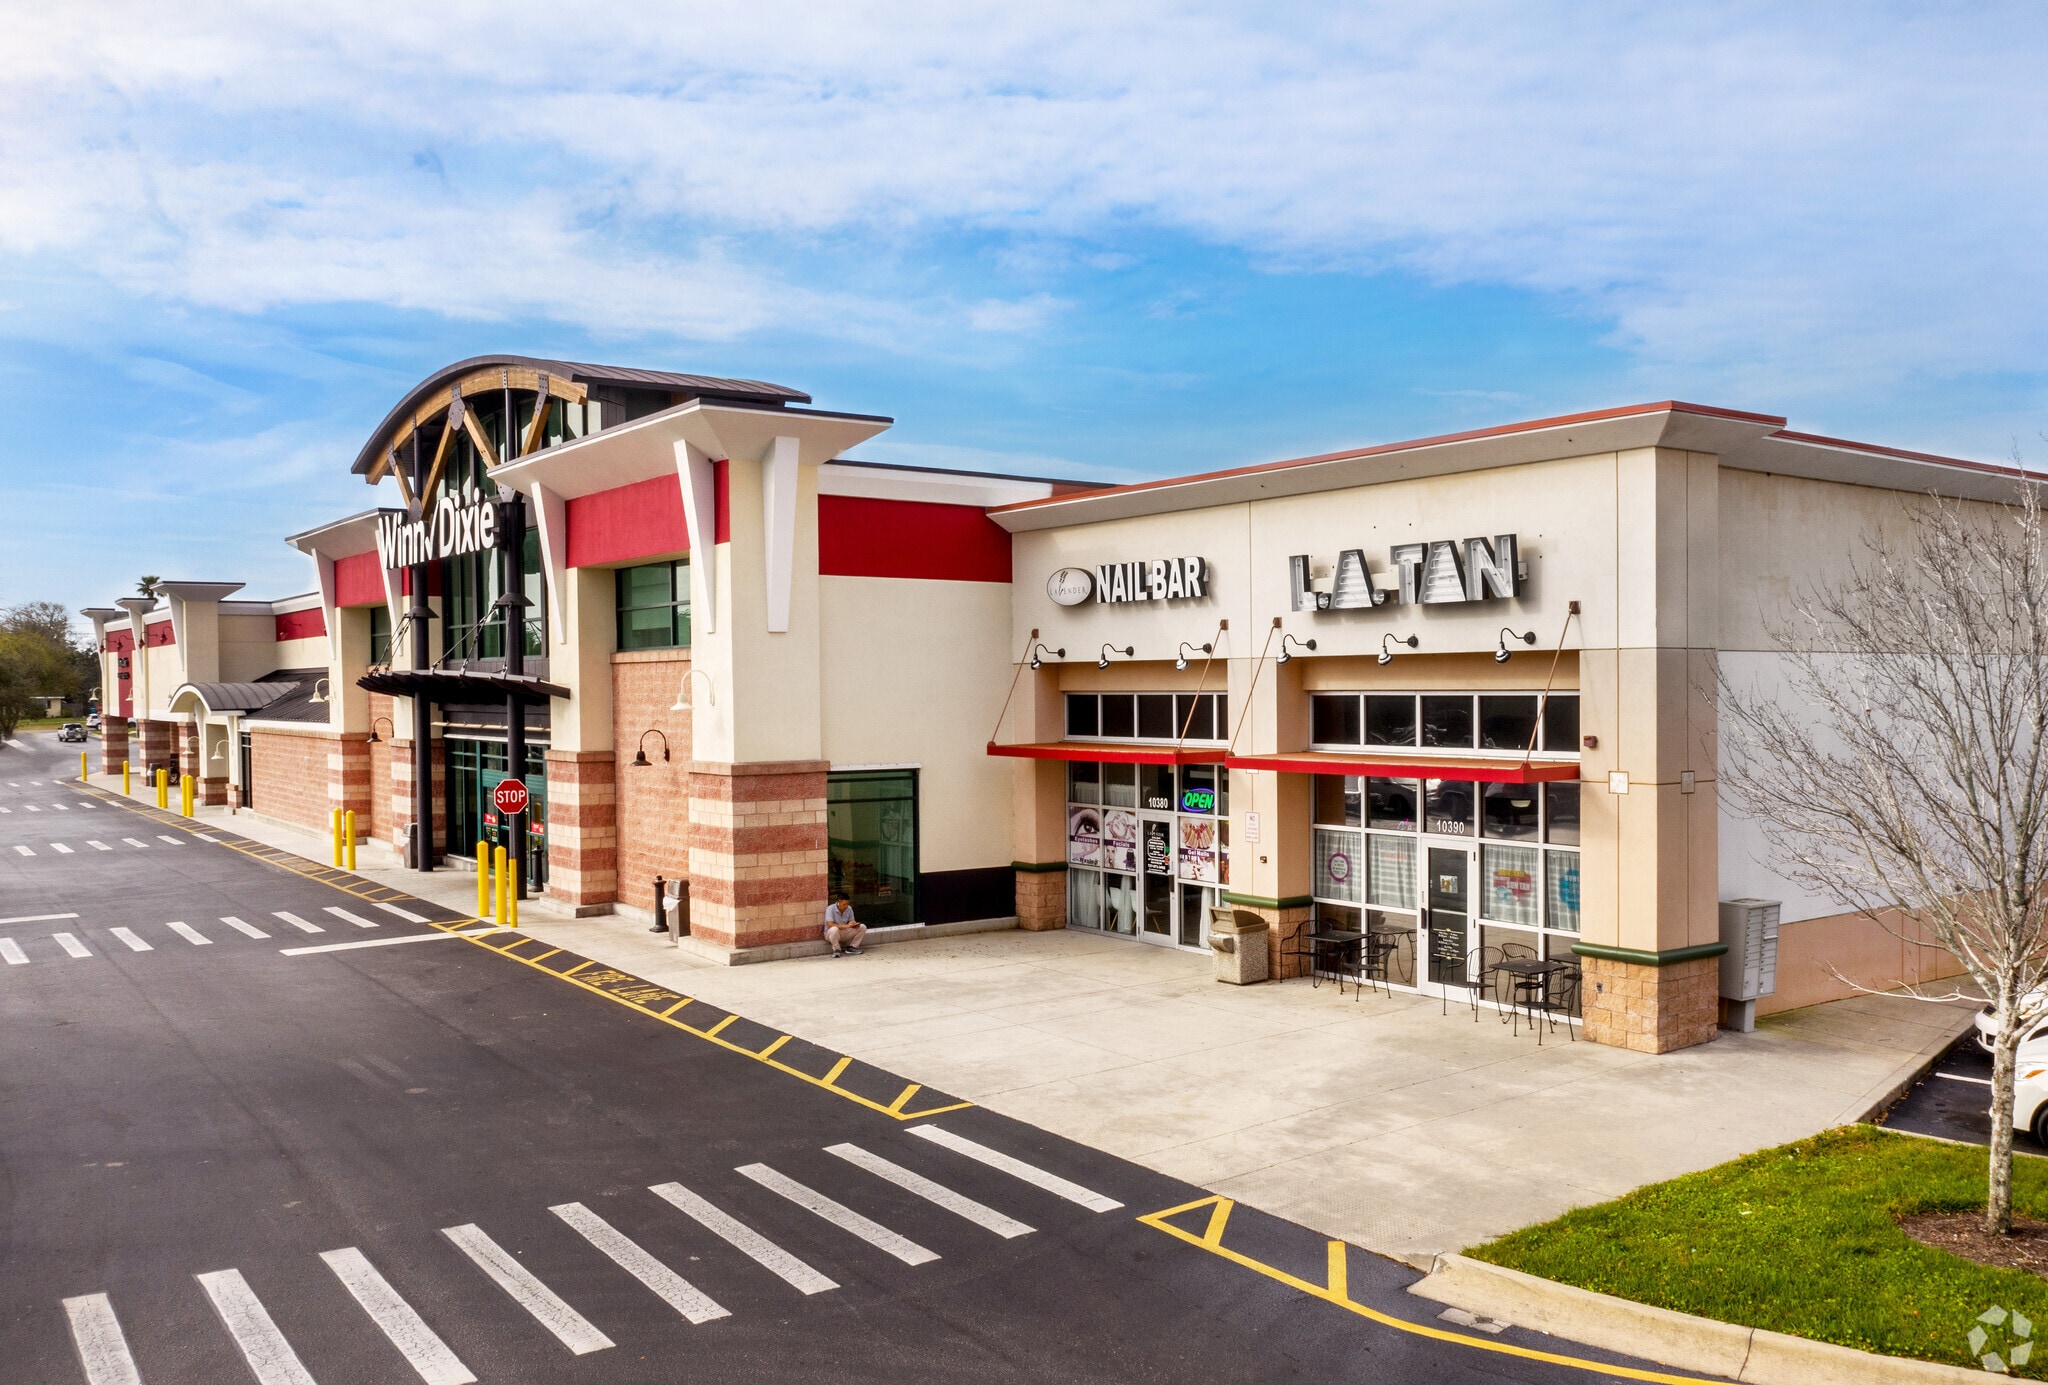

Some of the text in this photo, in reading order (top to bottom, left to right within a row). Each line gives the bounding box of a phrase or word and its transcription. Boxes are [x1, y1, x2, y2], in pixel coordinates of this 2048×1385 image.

[378, 486, 497, 570] Winn Dixie
[1096, 556, 1206, 604] NAIL BAR
[1289, 533, 1521, 612] L.A. TAN
[496, 789, 526, 804] STOP
[1148, 796, 1169, 809] 10380
[1184, 792, 1214, 809] OPEN
[1436, 819, 1465, 834] 10390
